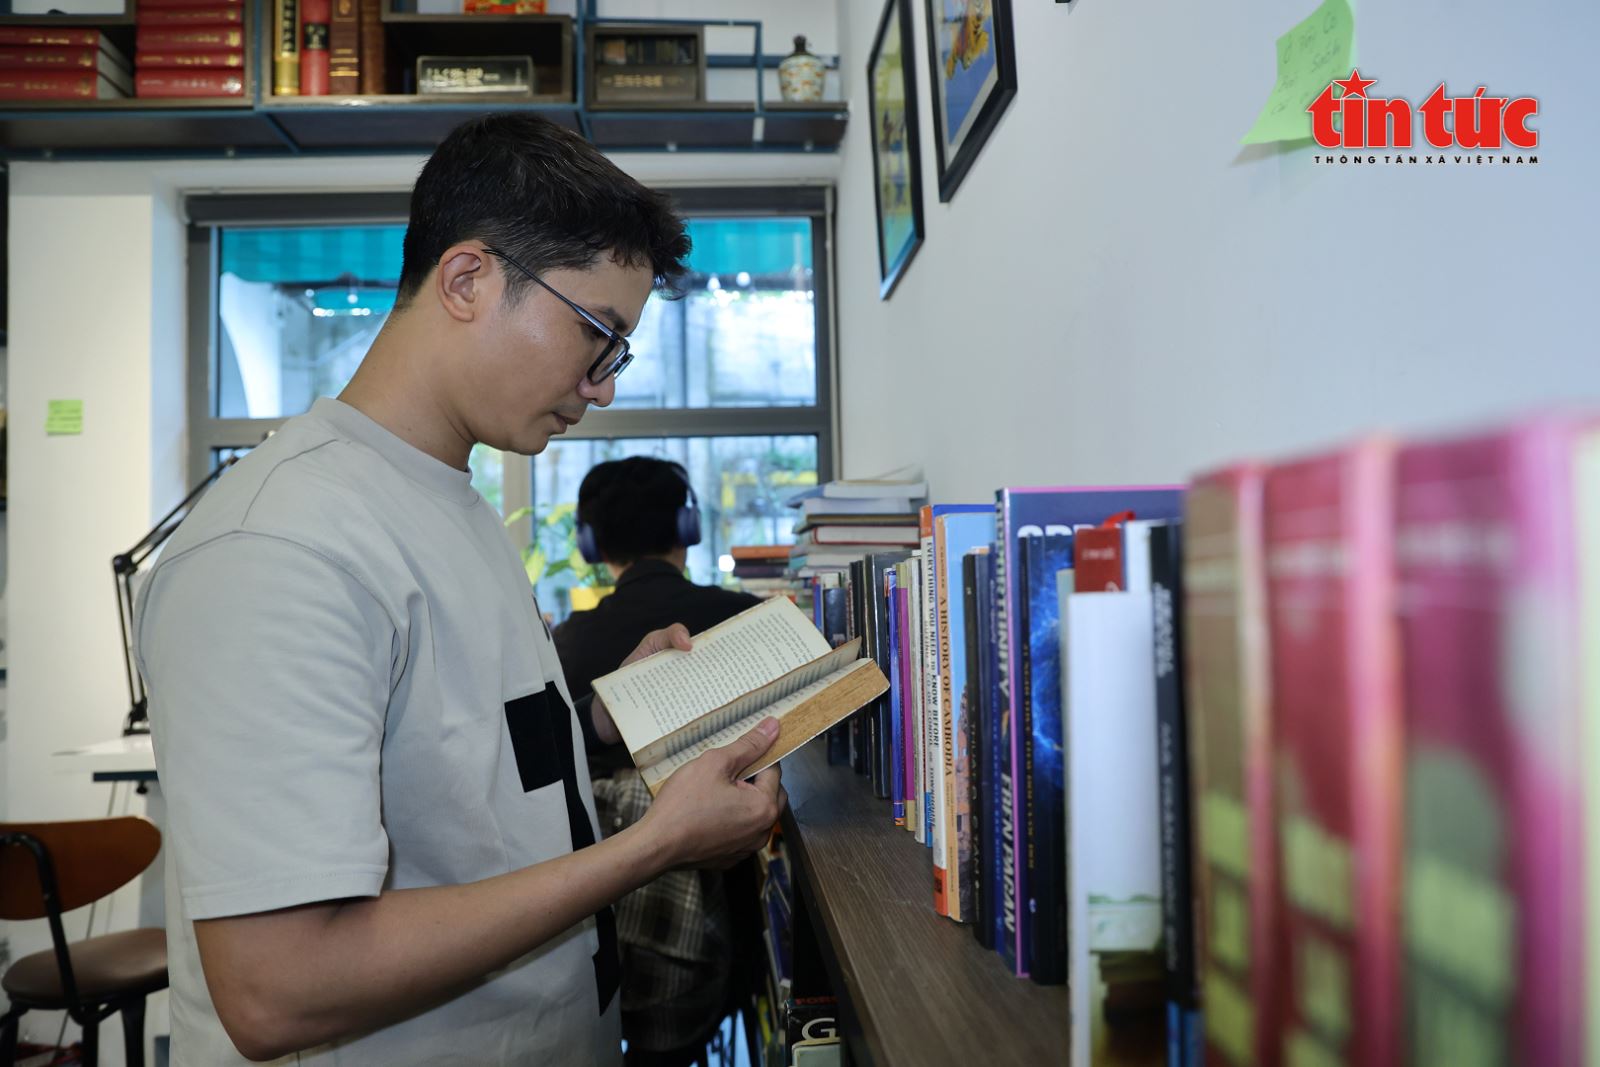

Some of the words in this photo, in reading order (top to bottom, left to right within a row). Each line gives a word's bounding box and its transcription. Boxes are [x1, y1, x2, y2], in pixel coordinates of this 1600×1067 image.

[926, 541, 936, 604] EVERYTHING
[931, 674, 939, 707] KNOW
[939, 595, 947, 605] A
[940, 608, 949, 673] HISTORY
[942, 675, 950, 695] OF
[943, 698, 953, 776] CAMBODIA
